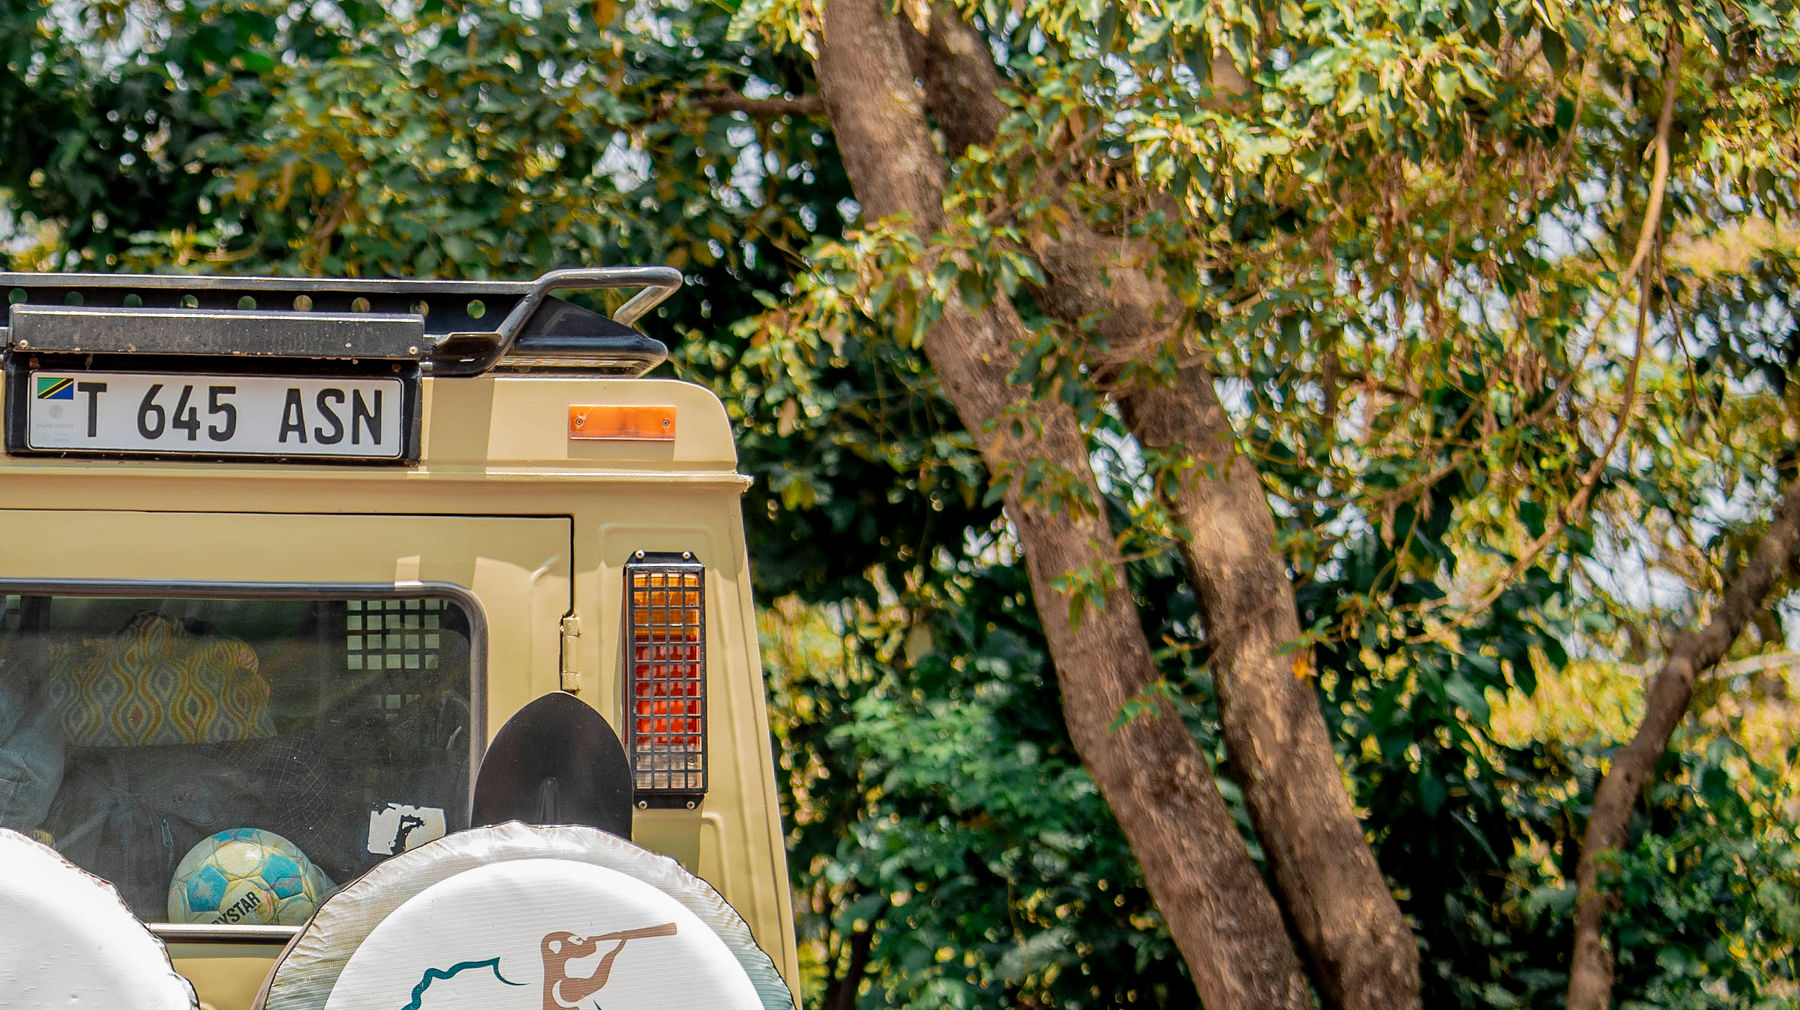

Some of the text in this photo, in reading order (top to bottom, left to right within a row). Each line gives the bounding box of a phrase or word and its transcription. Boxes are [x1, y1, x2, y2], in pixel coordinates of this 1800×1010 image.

[78, 382, 383, 445] T 645 ASN
